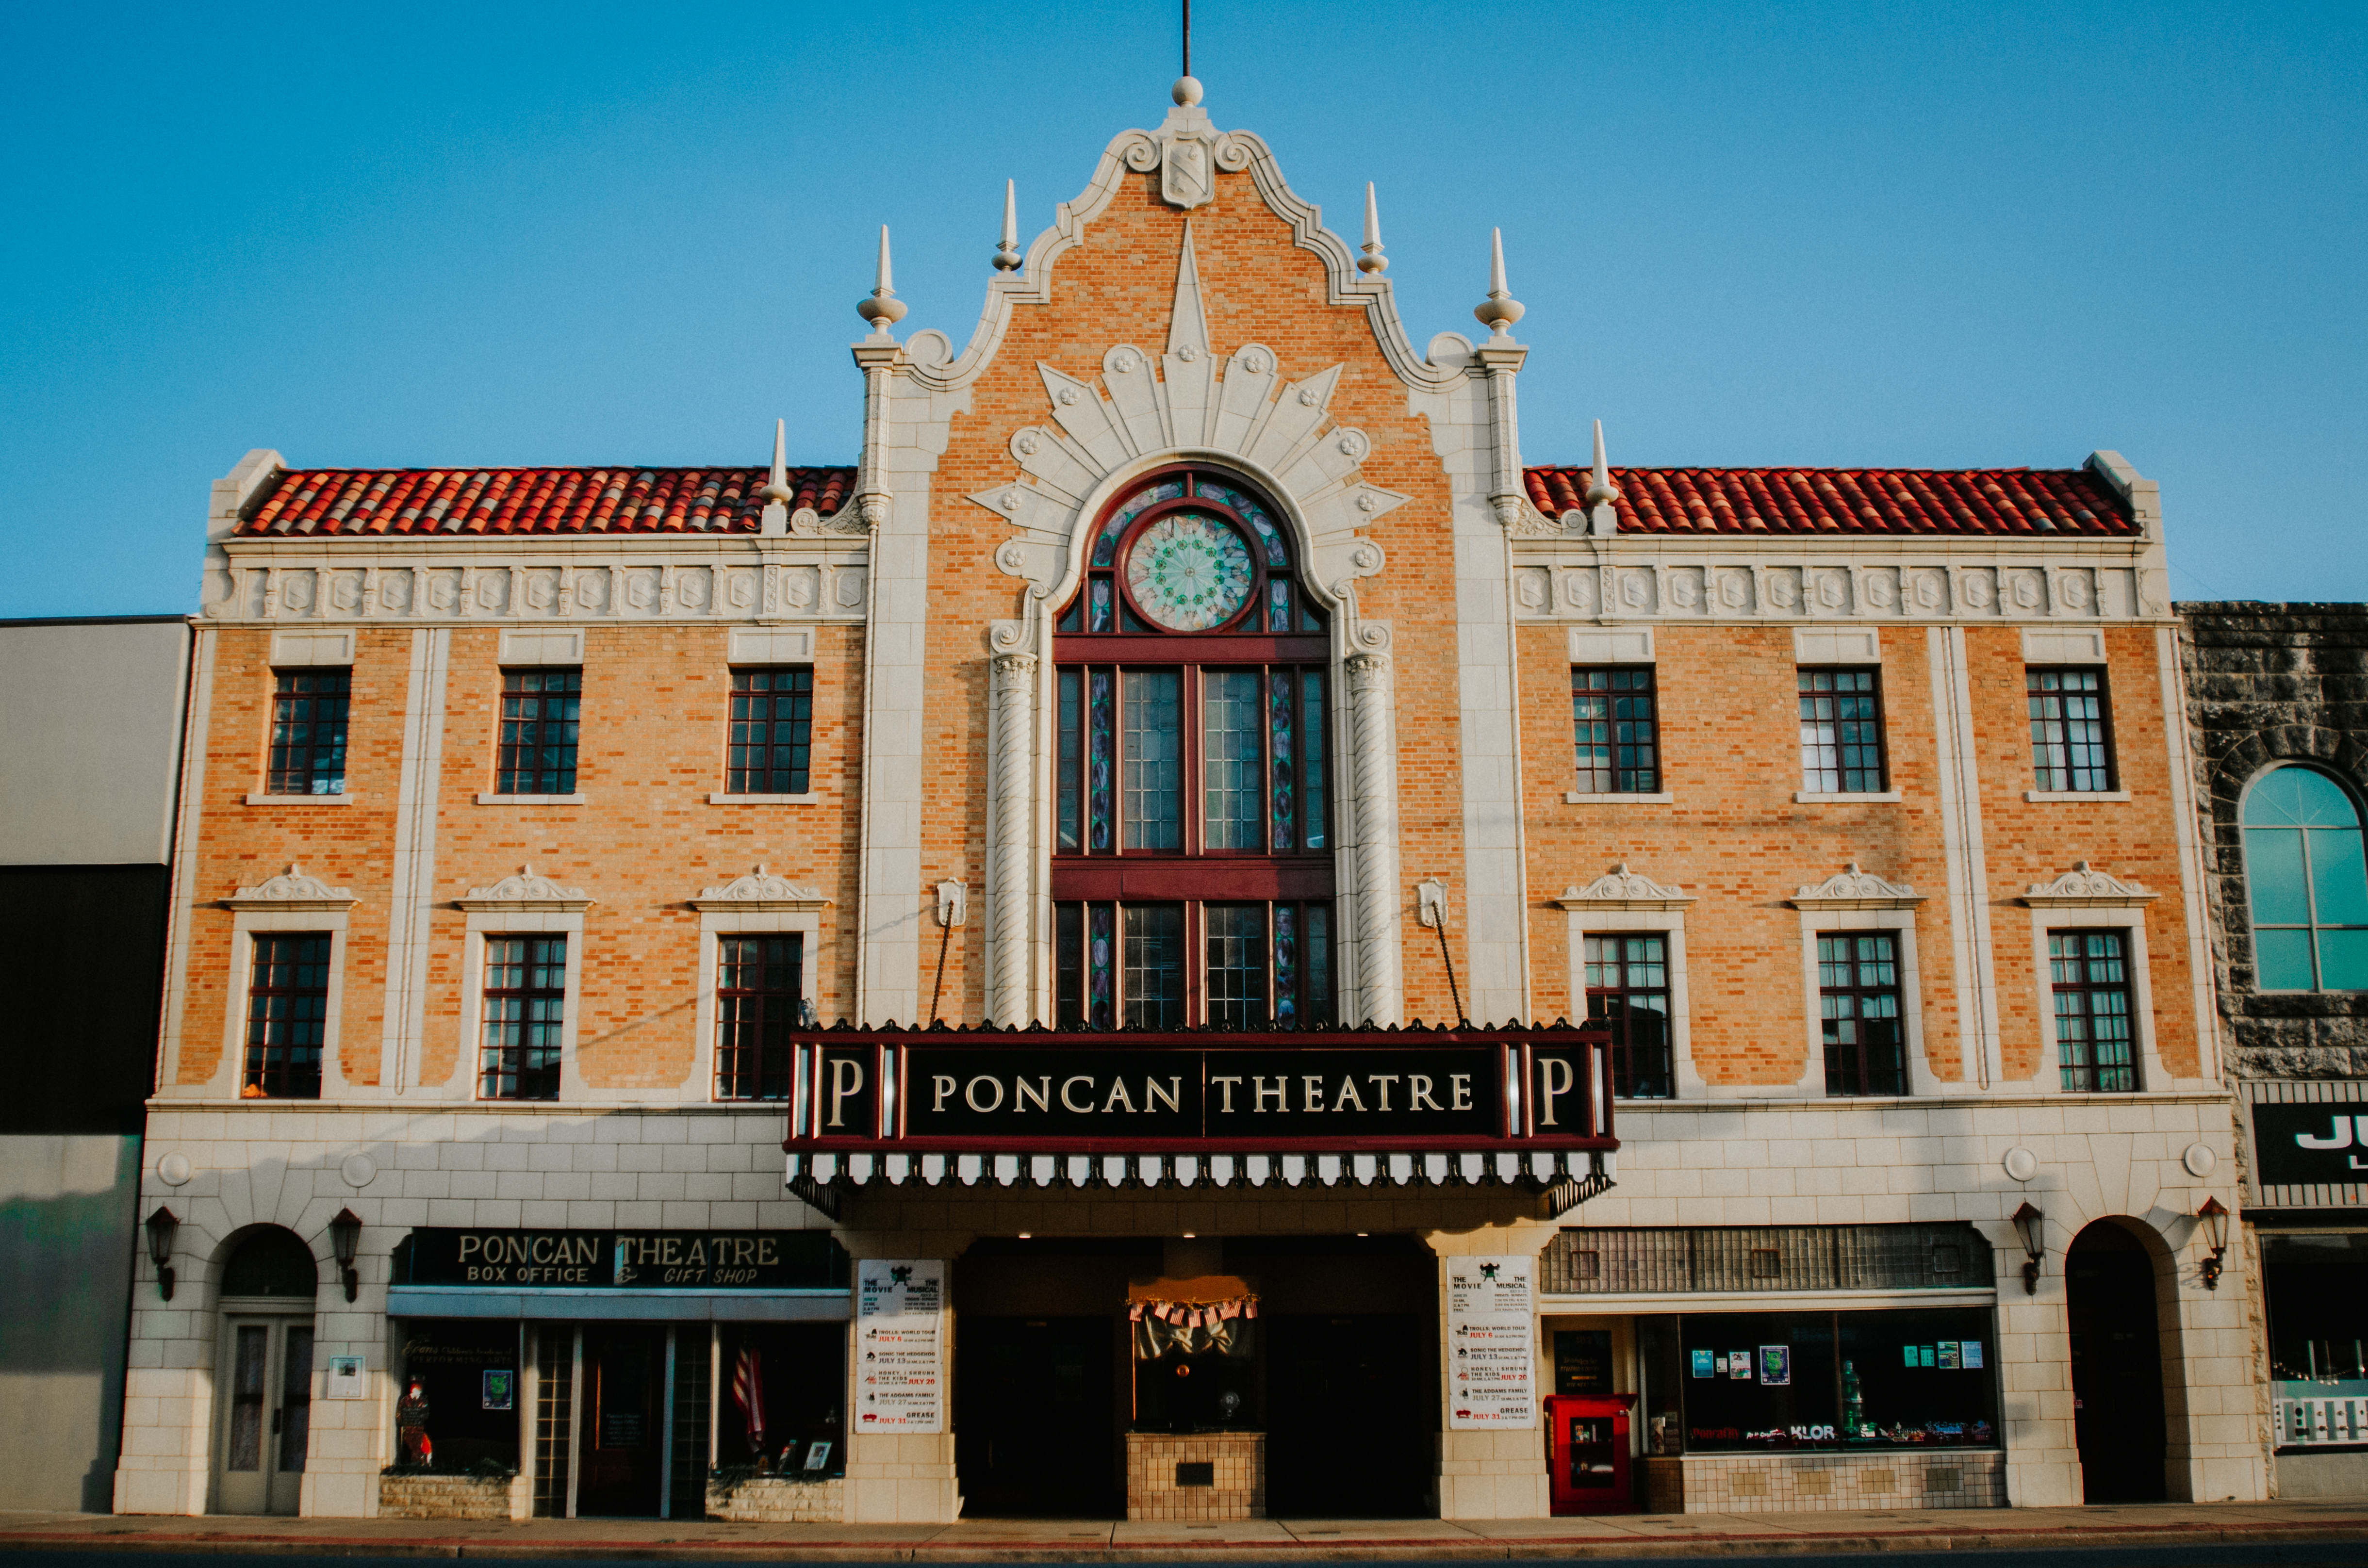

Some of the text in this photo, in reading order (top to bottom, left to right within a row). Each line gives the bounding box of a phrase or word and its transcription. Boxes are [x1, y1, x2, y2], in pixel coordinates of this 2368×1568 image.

[827, 1060, 863, 1126] P
[932, 1074, 1473, 1113] PONCAN THEATRE
[1538, 1059, 1573, 1125] P
[2295, 1115, 2368, 1149] J
[458, 1236, 778, 1265] PONCAN THEATRE
[468, 1267, 758, 1283] BOX OFFICE & GIFT SHOP
[1791, 1425, 1837, 1440] KLOR
